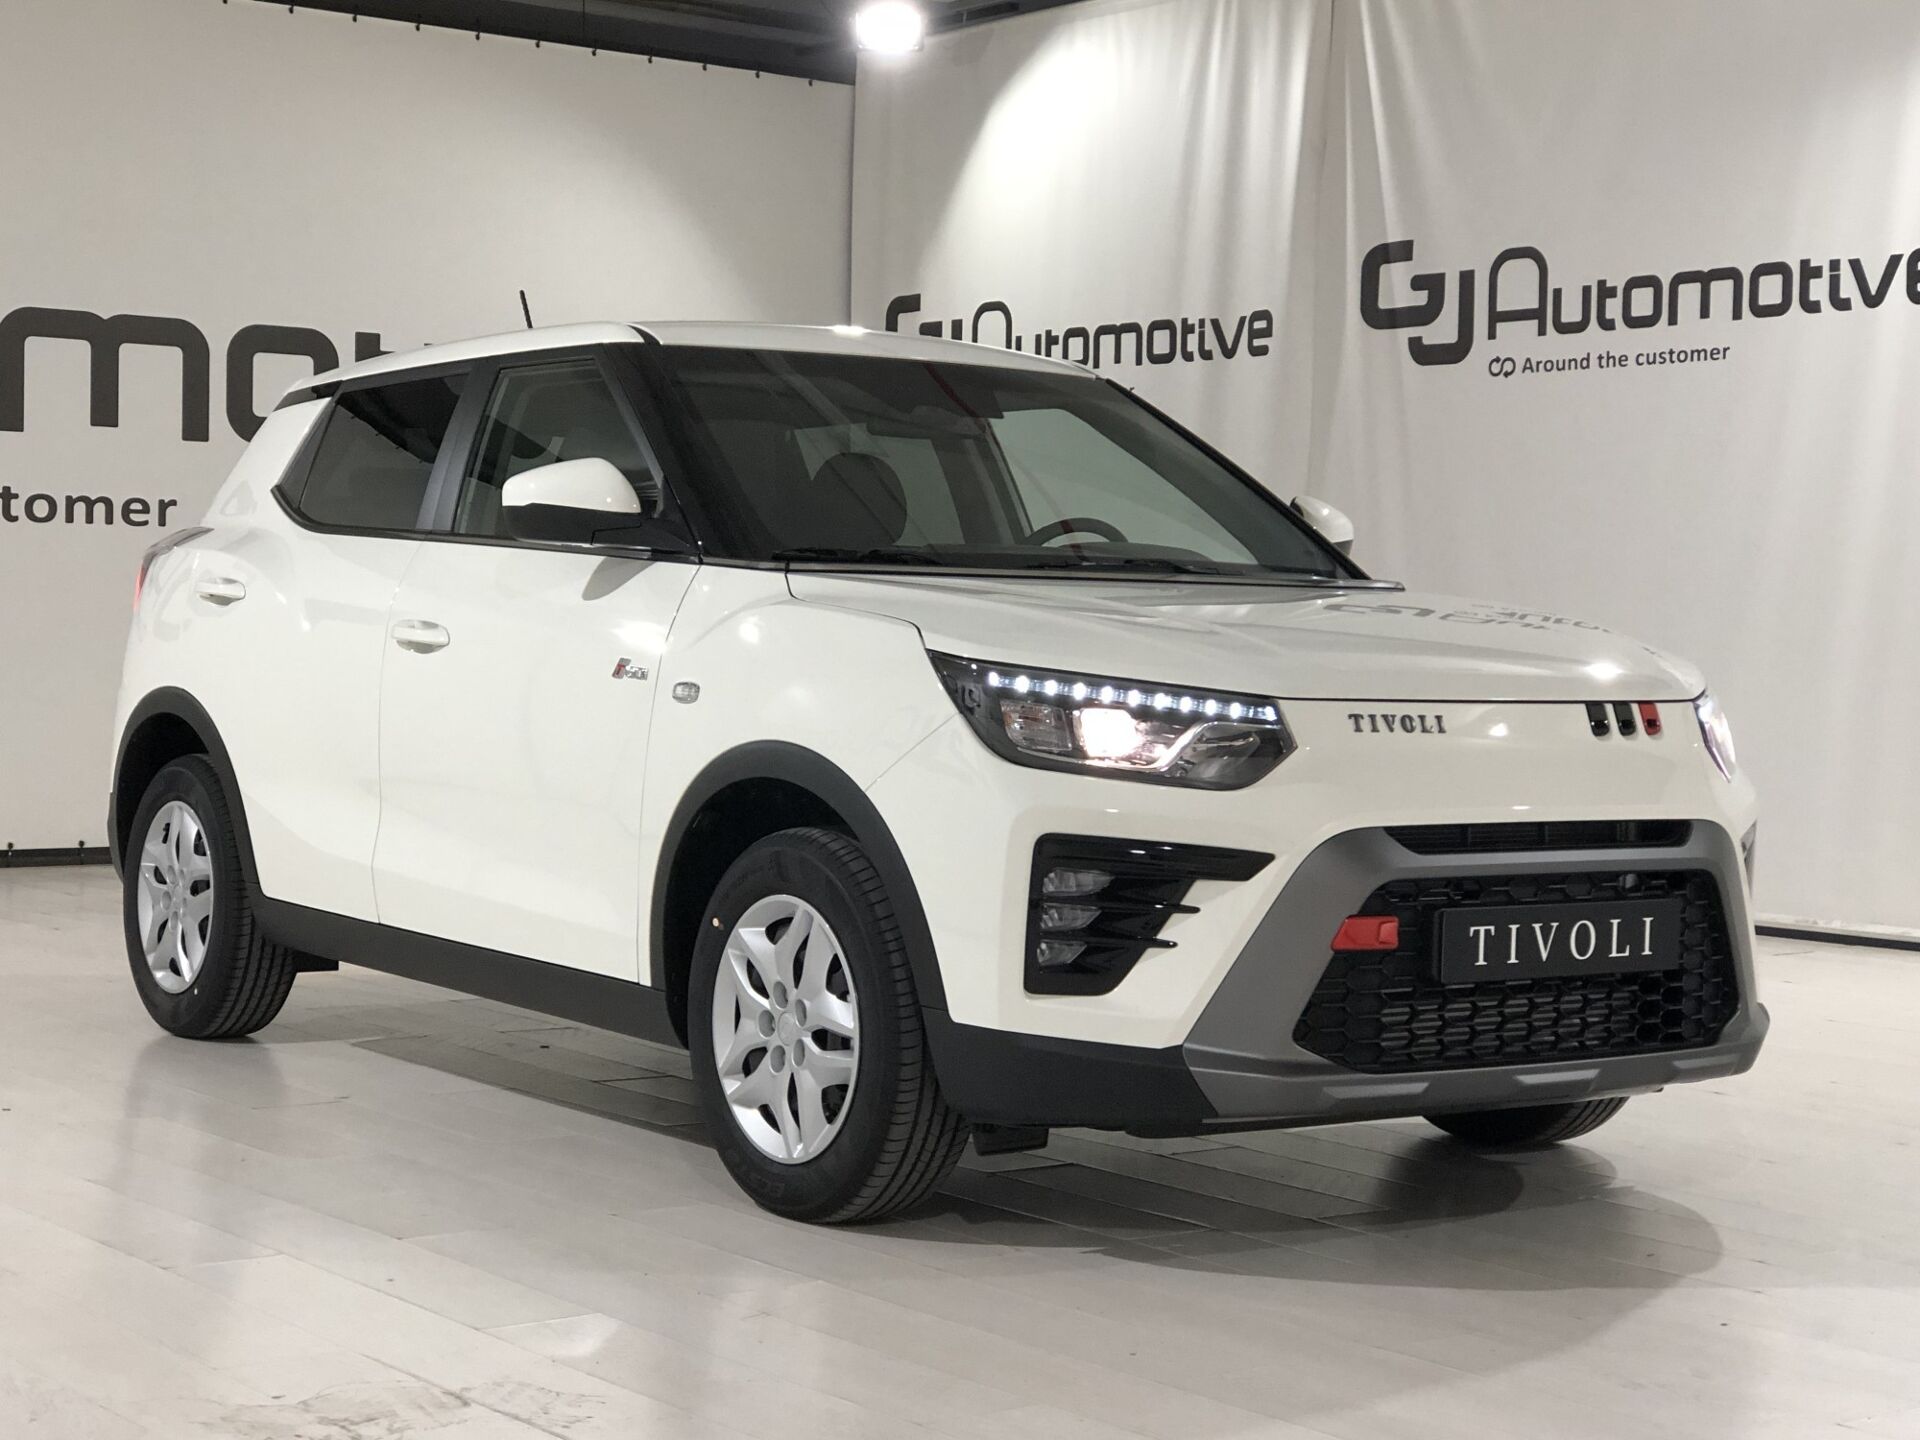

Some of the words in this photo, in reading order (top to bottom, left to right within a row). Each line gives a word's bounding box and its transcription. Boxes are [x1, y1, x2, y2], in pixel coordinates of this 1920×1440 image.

[1521, 352, 1591, 374] Around
[1597, 350, 1629, 369] the
[1635, 344, 1731, 367] customer
[0, 485, 178, 528] tomer
[1347, 713, 1447, 734] TIVOLI
[1468, 916, 1655, 966] TIVOLI
